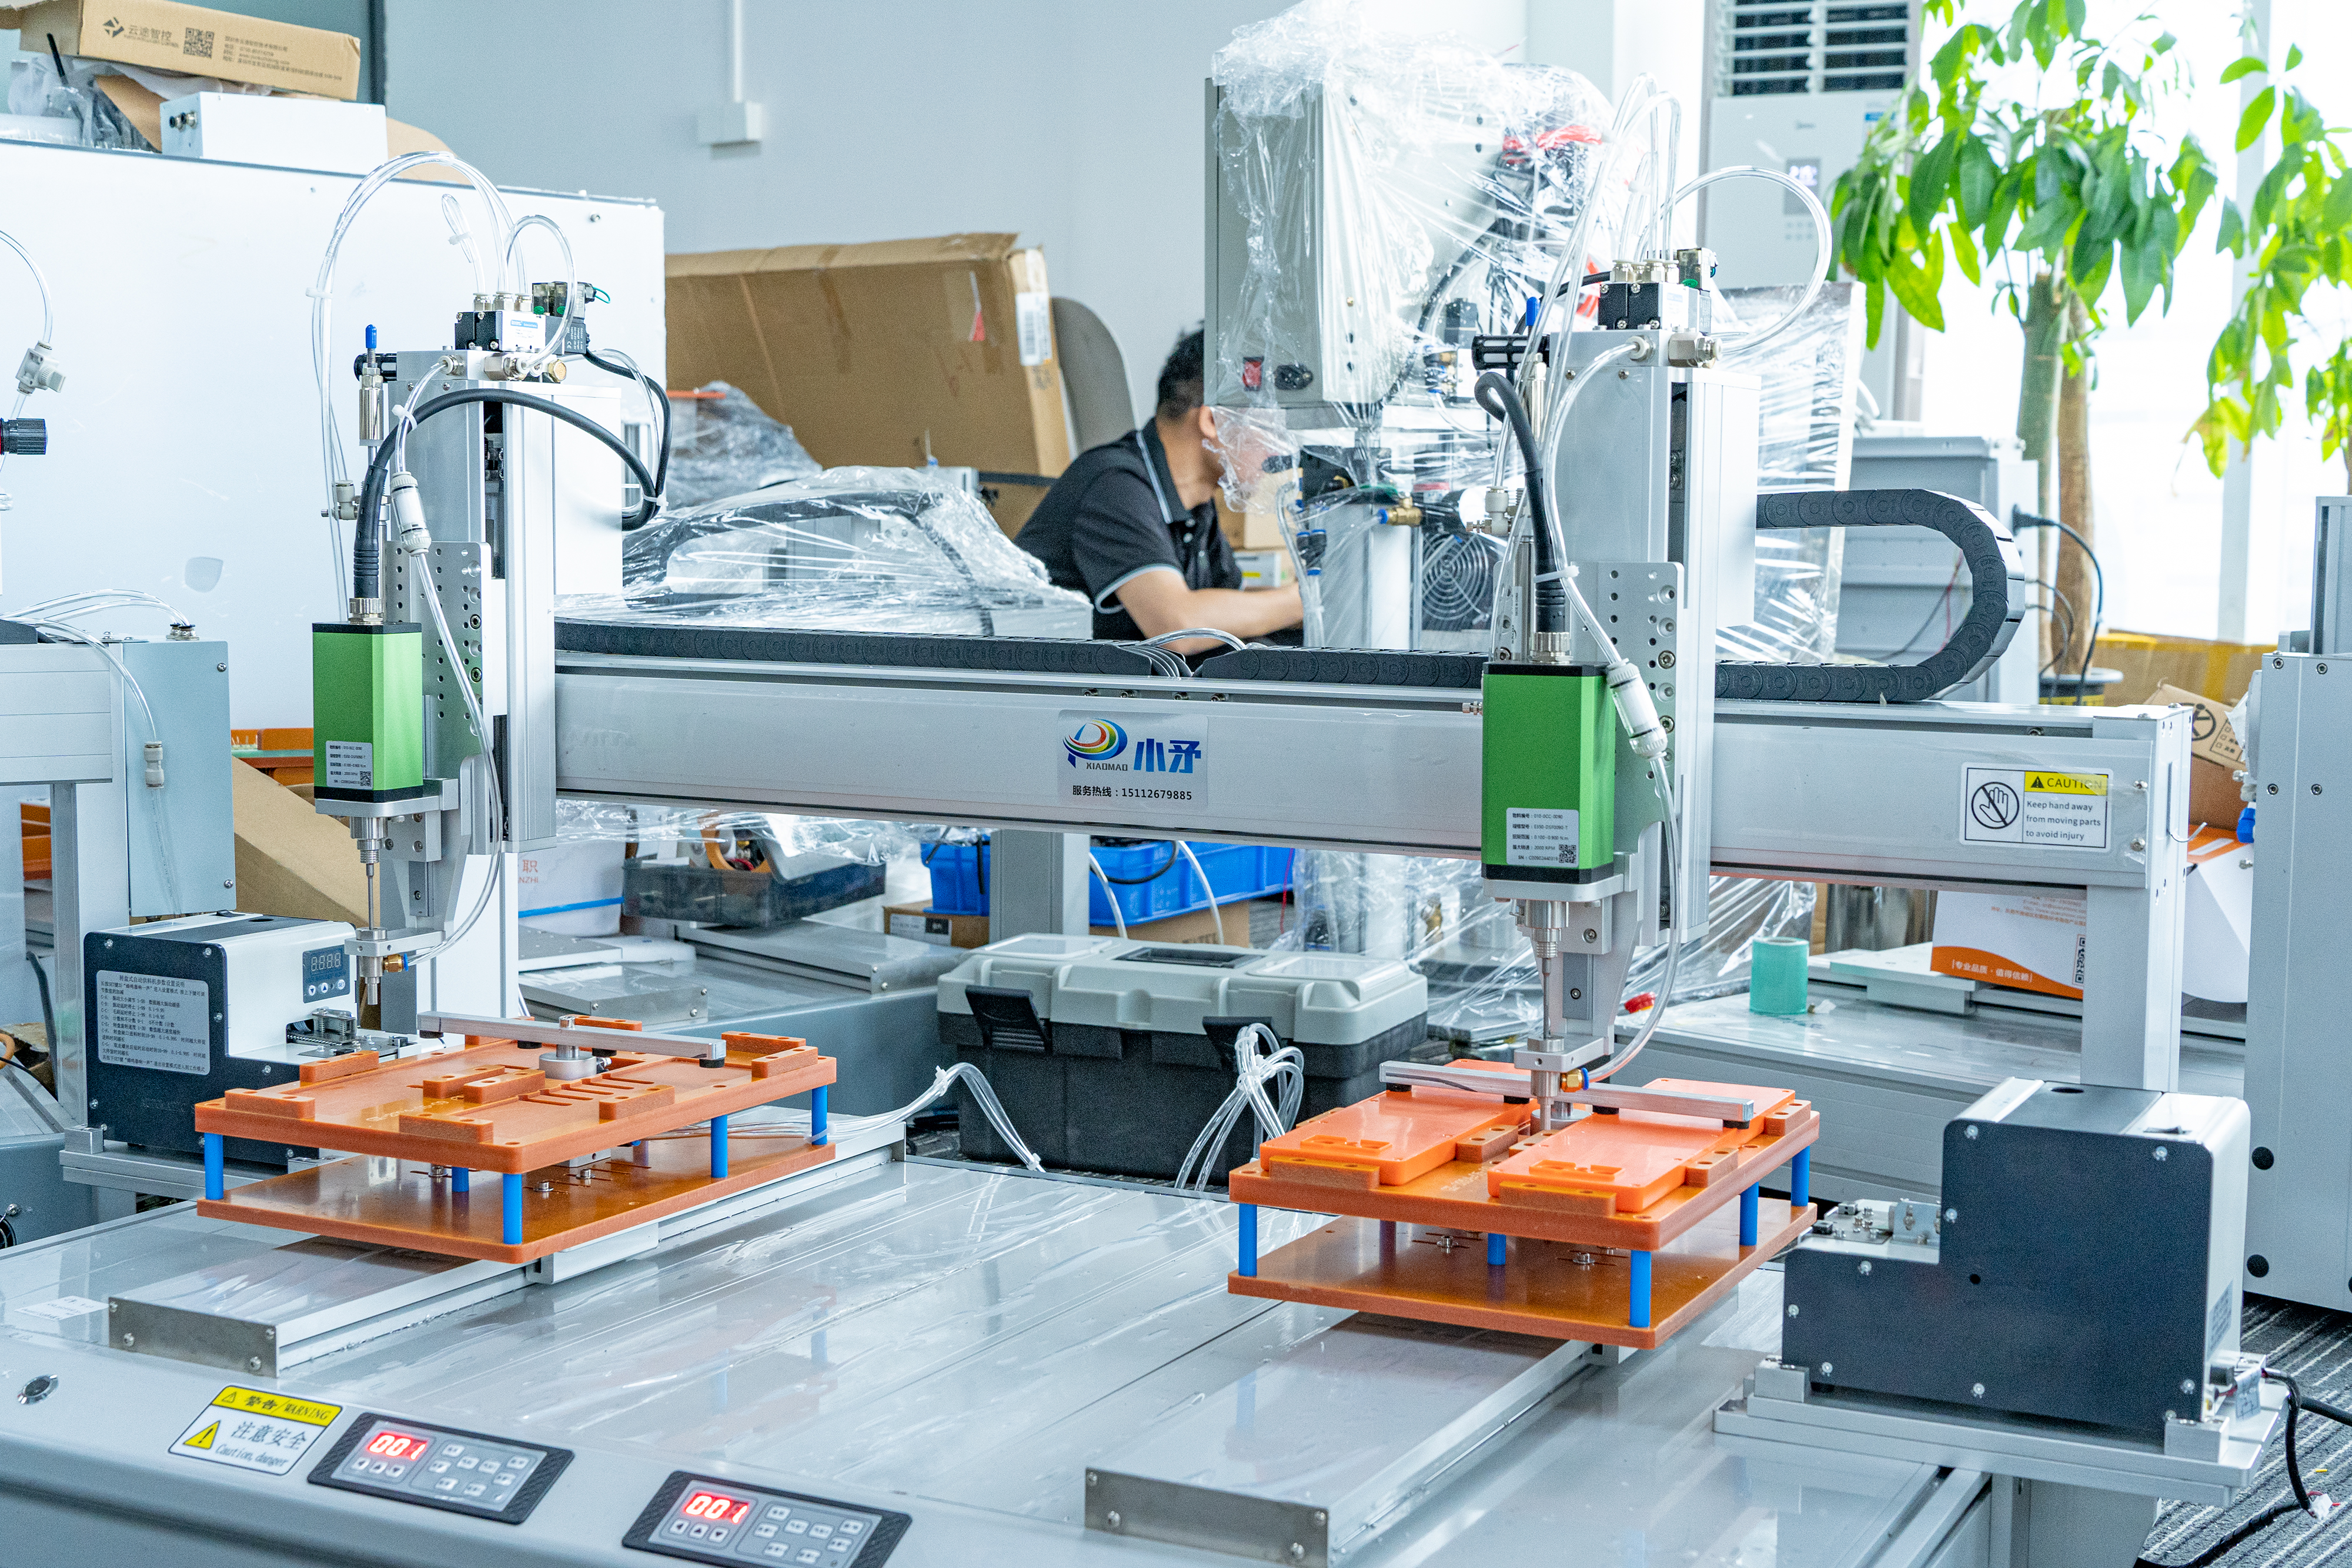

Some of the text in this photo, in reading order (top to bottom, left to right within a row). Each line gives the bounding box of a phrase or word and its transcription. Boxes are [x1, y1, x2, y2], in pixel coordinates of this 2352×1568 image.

[1133, 738, 1201, 774] 小矛
[1086, 762, 1128, 771] XIAOMAO
[2047, 778, 2102, 789] CAUTION
[2027, 801, 2047, 810] Keep
[2049, 801, 2070, 810] hand
[2047, 816, 2078, 826] moving
[2060, 831, 2084, 841] injury
[522, 859, 538, 873] 职
[230, 1421, 307, 1450] 注意安全
[369, 1435, 426, 1460] 001
[255, 1452, 289, 1467] danger
[685, 1495, 748, 1524] 001
